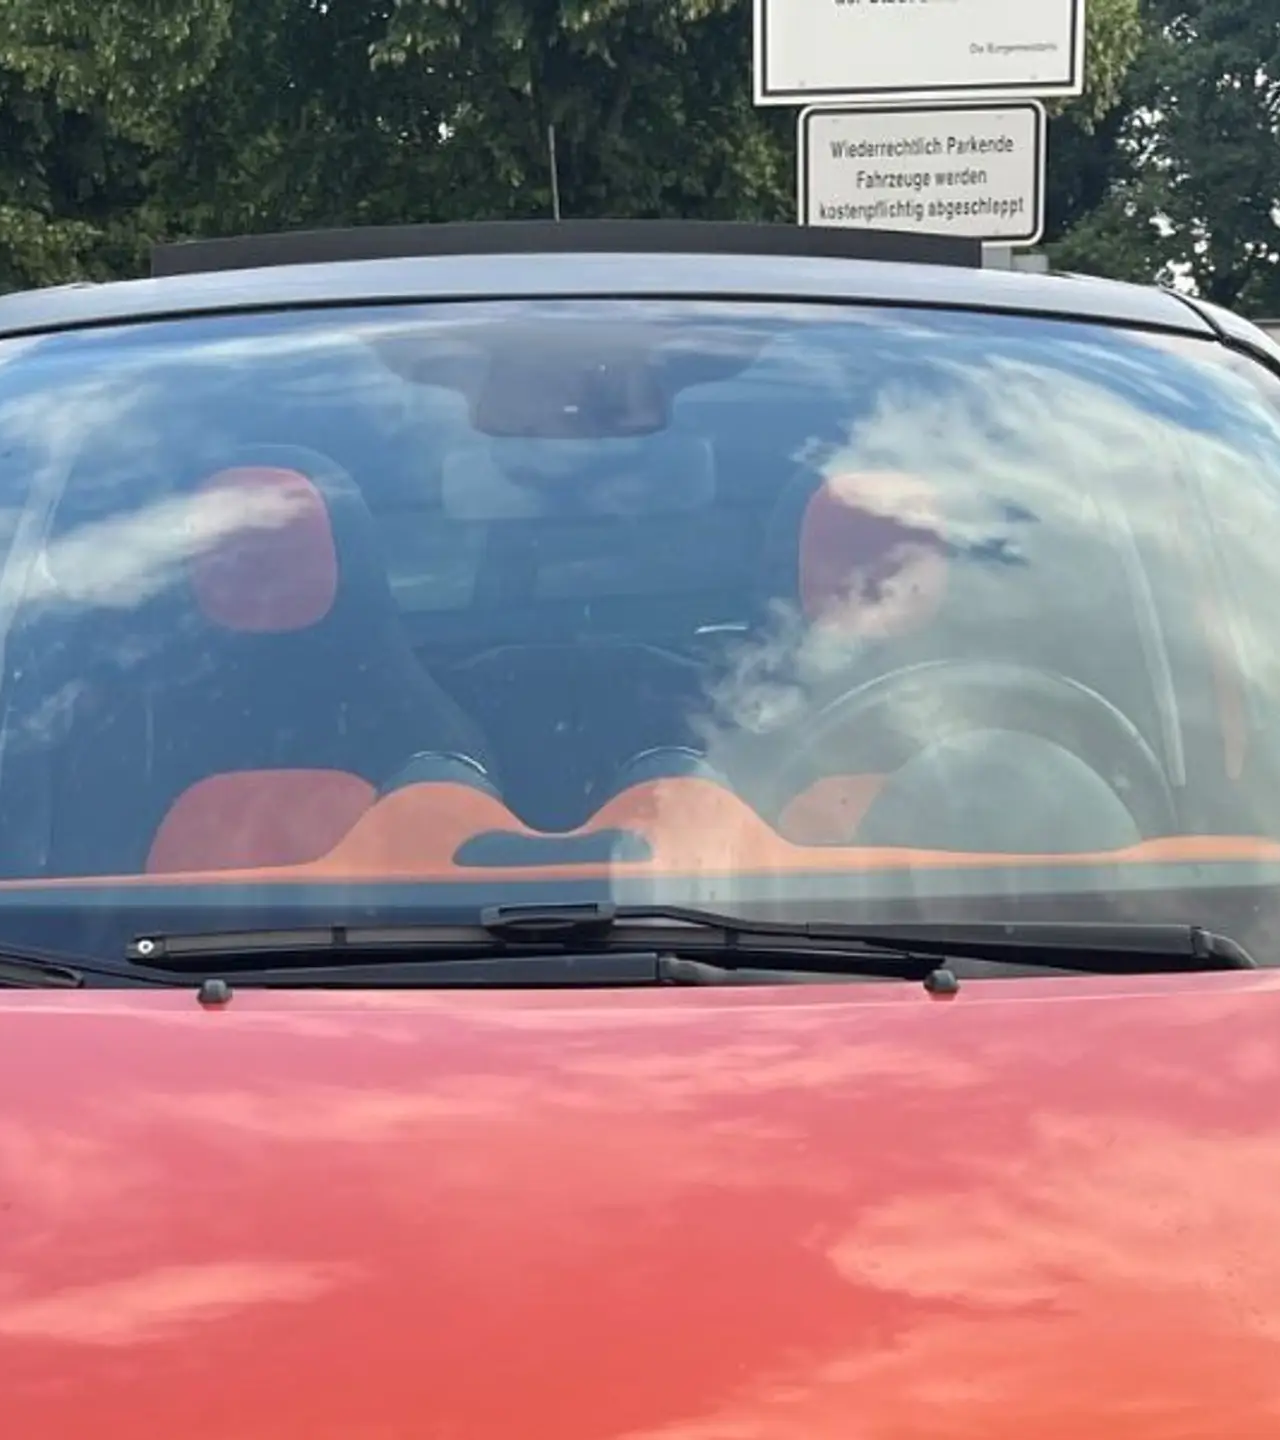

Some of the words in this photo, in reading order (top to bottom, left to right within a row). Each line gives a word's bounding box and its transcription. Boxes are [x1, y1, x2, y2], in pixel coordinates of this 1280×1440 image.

[830, 138, 942, 159] Wiederrechtlich
[947, 136, 1014, 154] Parkende
[856, 171, 931, 190] Fahrzeuge
[935, 168, 988, 186] werden
[819, 199, 925, 222] kostenpflichtig
[928, 196, 1024, 220] abgeschleppt
